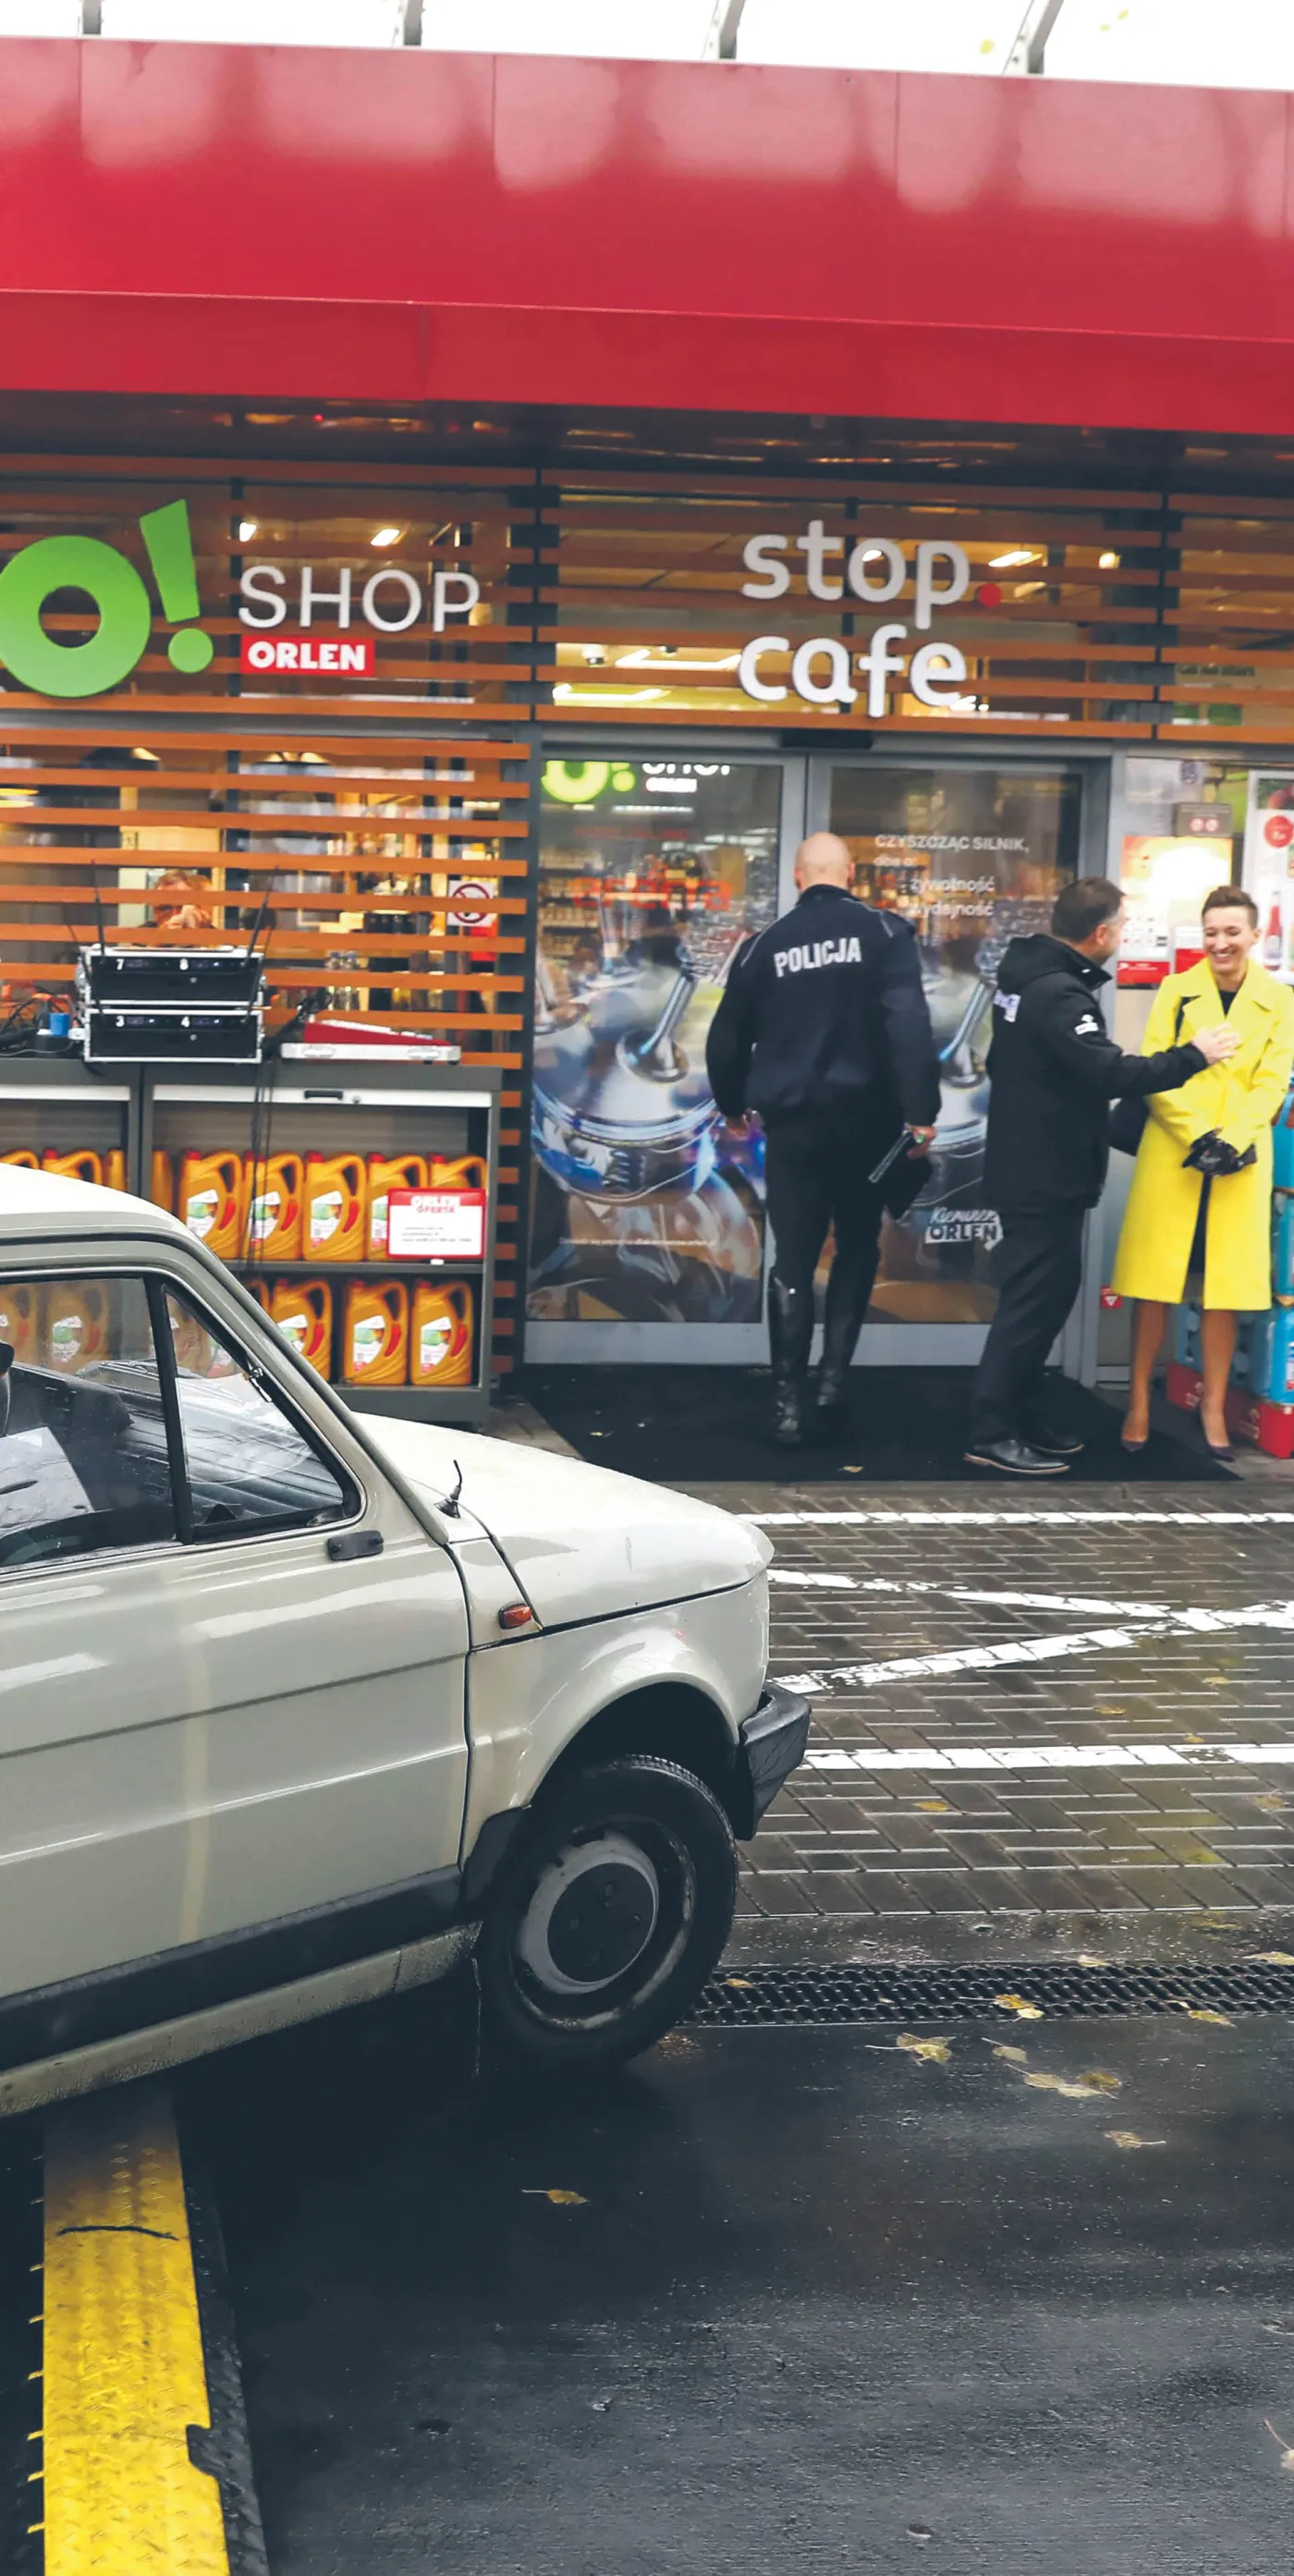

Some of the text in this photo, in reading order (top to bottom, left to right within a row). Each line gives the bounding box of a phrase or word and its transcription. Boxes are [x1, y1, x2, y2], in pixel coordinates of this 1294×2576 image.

[0, 499, 480, 699] O! SHOP
[247, 641, 366, 672] ORLEN
[738, 624, 967, 719] cafe
[116, 958, 125, 971] 7
[774, 936, 861, 978] POLICJA
[116, 1016, 125, 1027] 3
[181, 1016, 189, 1028] 4
[930, 1223, 997, 1240] ORLEN
